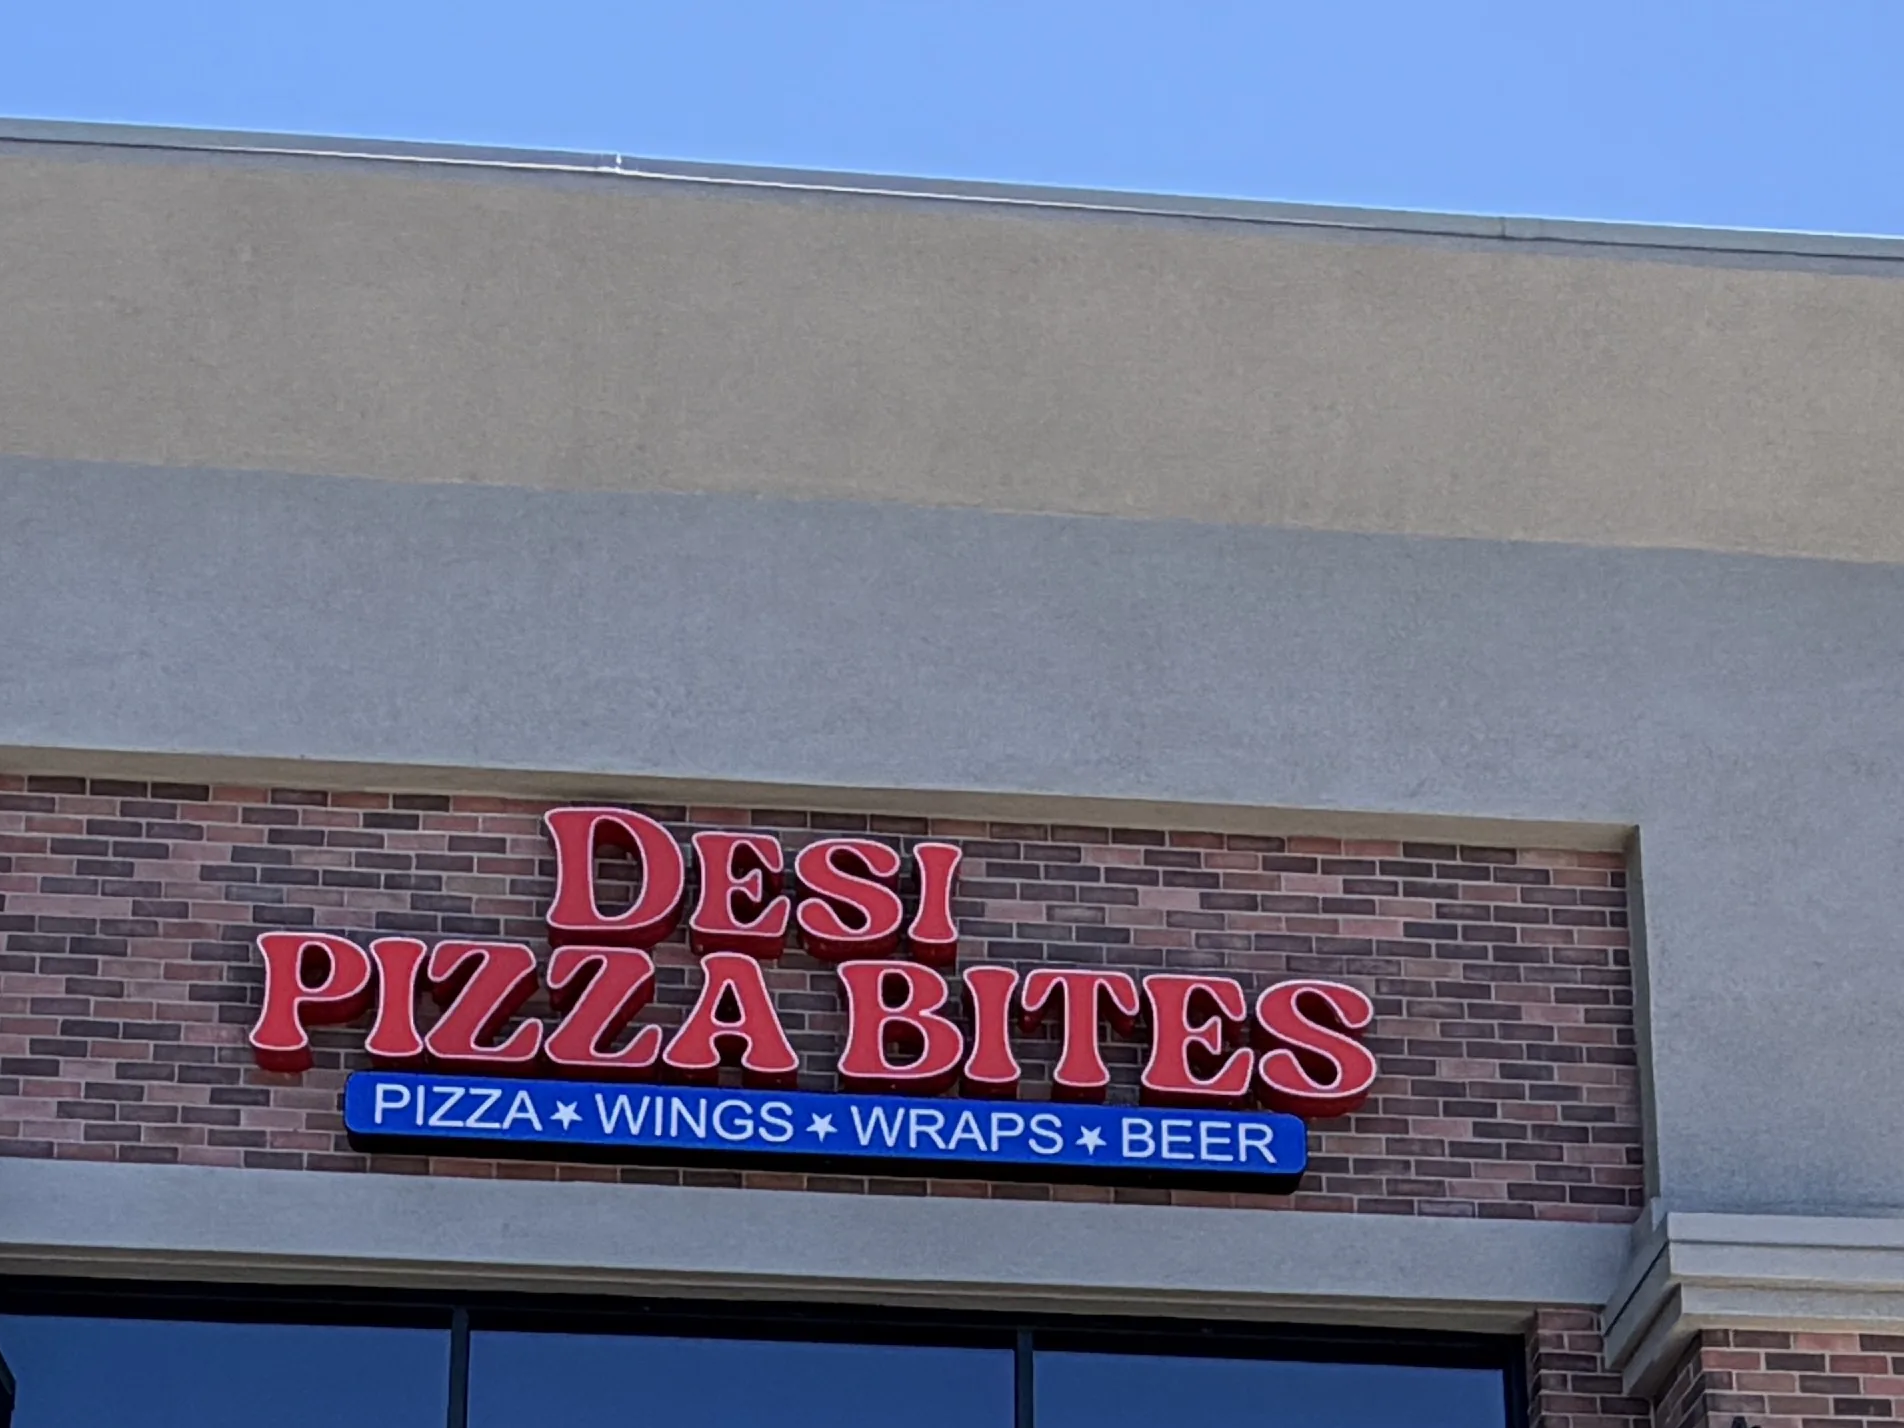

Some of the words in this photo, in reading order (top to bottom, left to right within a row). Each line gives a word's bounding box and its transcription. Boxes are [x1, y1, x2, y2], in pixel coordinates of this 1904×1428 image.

[543, 804, 963, 960] DESI
[249, 930, 799, 1084] PIZZA
[836, 957, 1379, 1104] BITES
[372, 1082, 544, 1134] PIZZA
[594, 1091, 795, 1145] WINGS
[851, 1103, 1064, 1157] WRAPS
[1122, 1116, 1278, 1165] BEER
